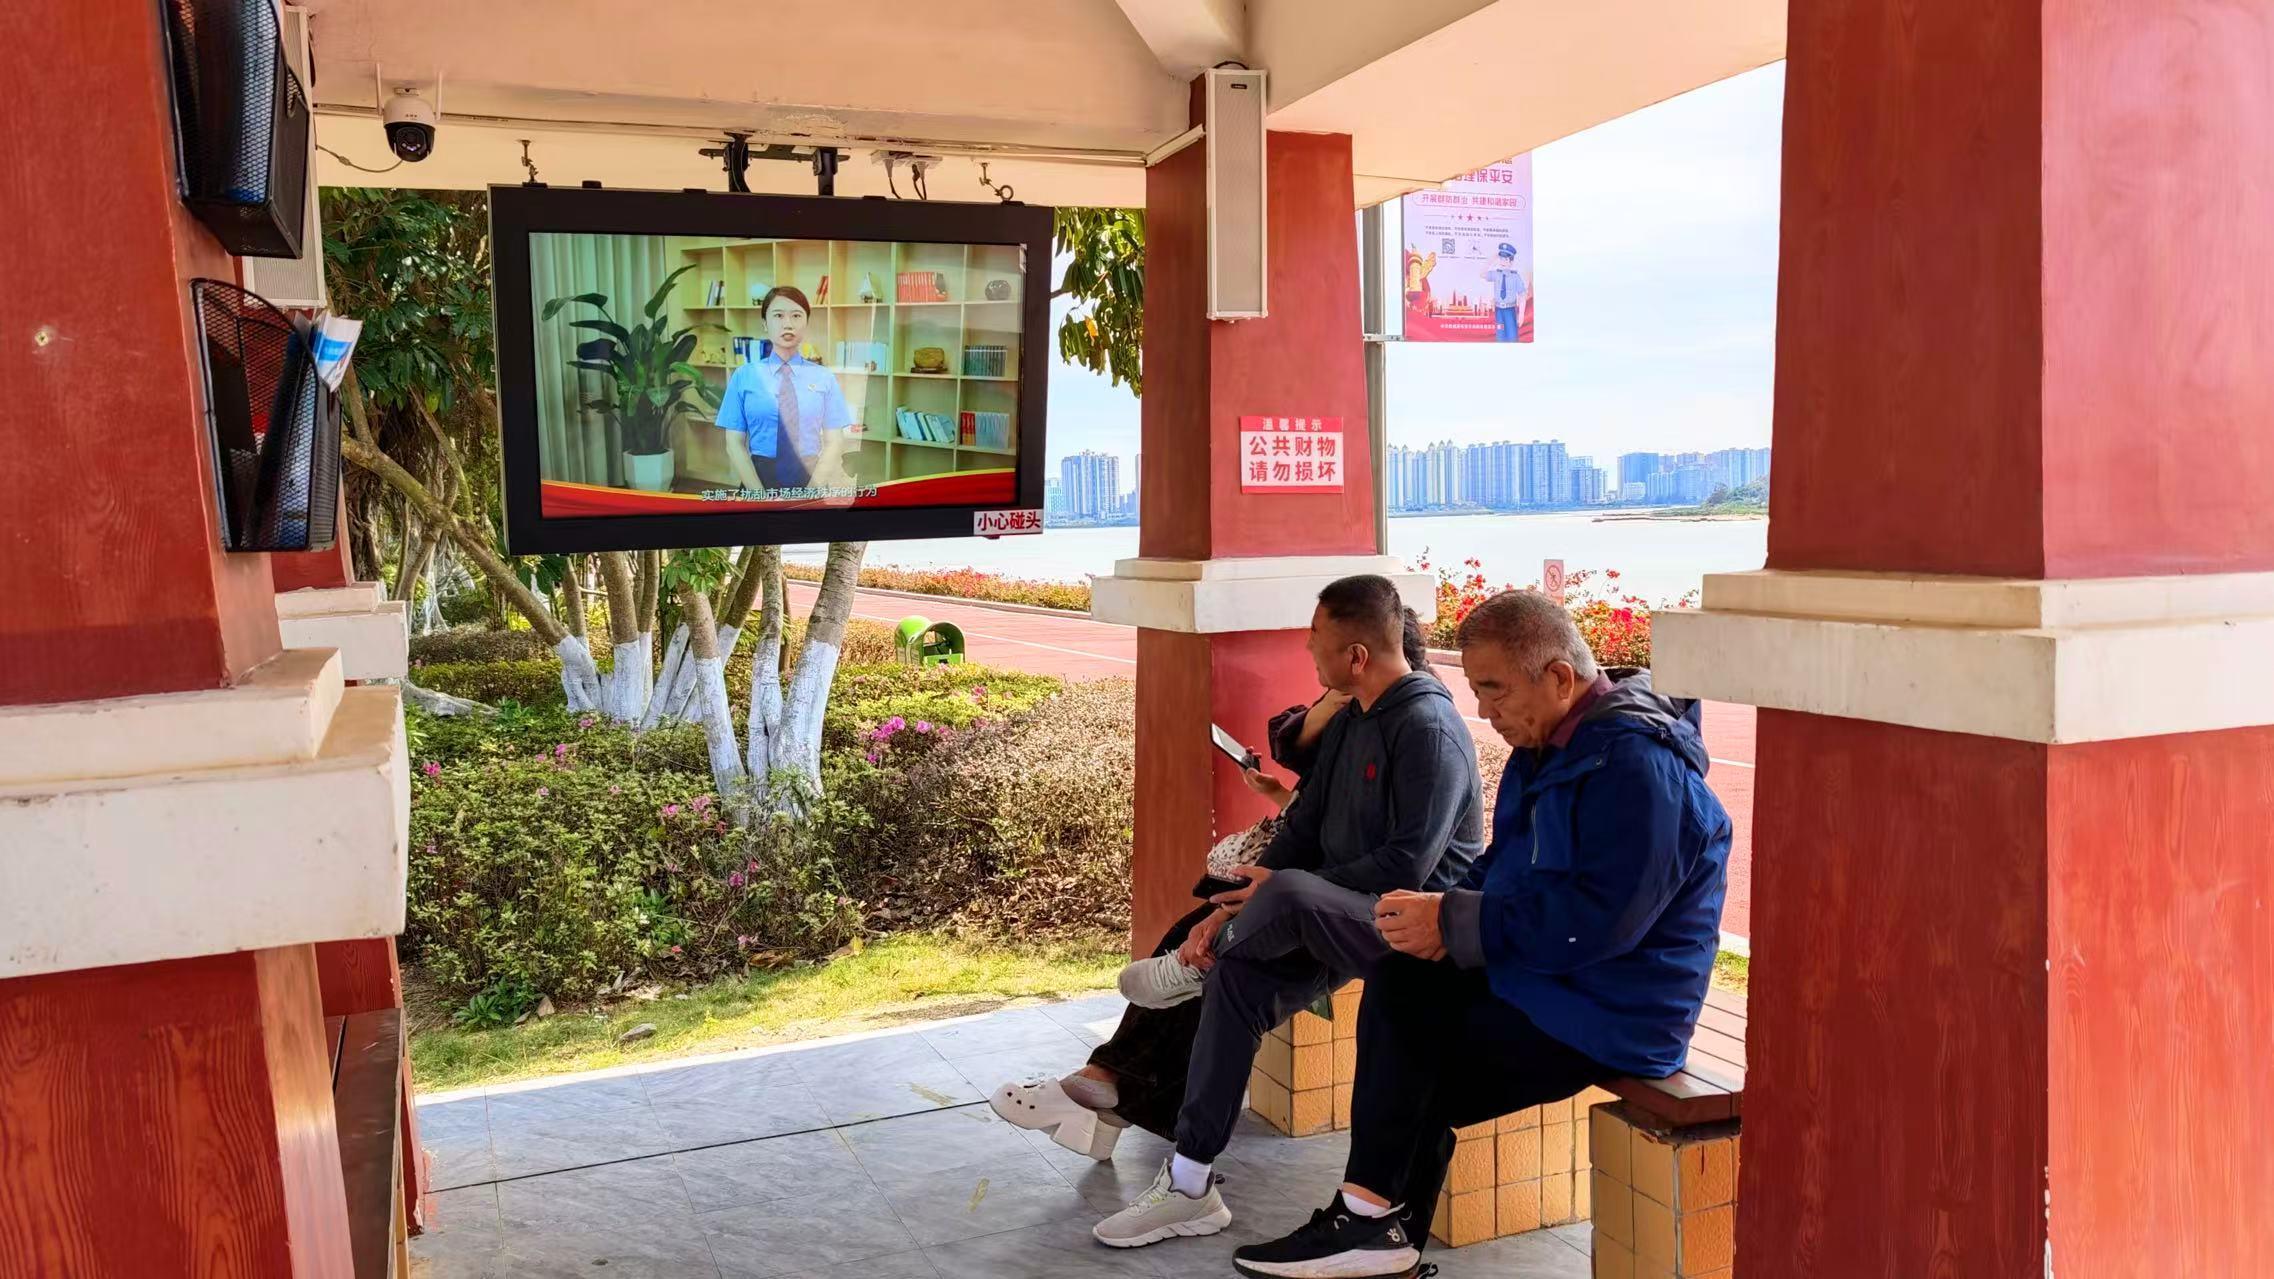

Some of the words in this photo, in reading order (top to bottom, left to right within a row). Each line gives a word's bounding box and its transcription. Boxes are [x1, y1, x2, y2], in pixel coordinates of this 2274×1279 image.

[1249, 436, 1336, 457] 公共财物
[1249, 461, 1337, 482] 请勿损坏
[701, 485, 878, 502] 实施了扰乱市场经济秩序的行为
[977, 511, 1041, 531] 小心碰头
